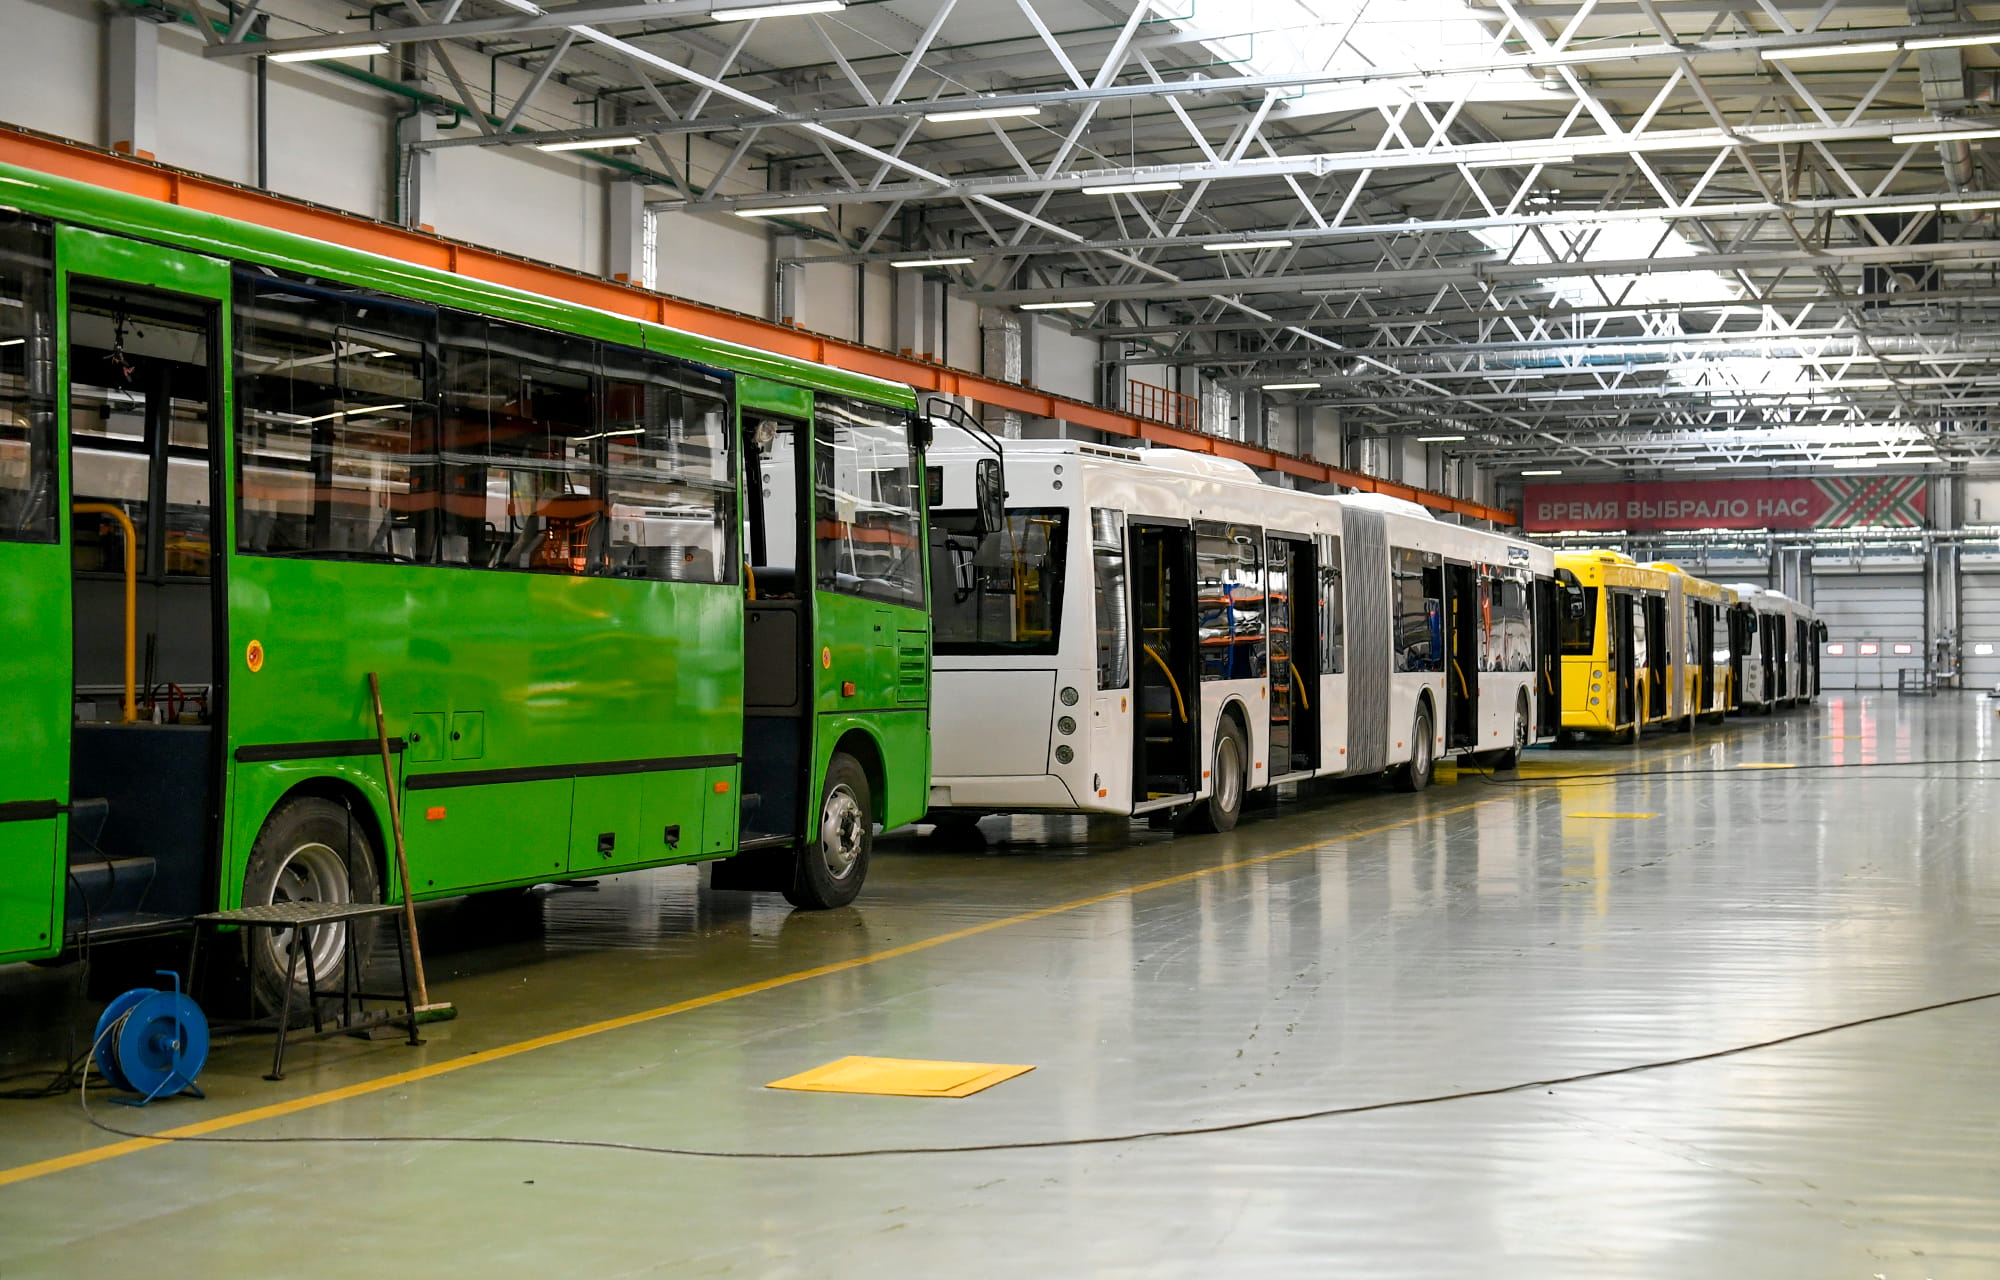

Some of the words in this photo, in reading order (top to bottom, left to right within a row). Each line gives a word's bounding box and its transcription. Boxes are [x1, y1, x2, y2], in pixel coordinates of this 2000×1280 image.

[1538, 501, 1619, 521] ВРЕМЯ
[1626, 499, 1749, 519] ВЫБРАЛО
[1757, 498, 1809, 517] НАС
